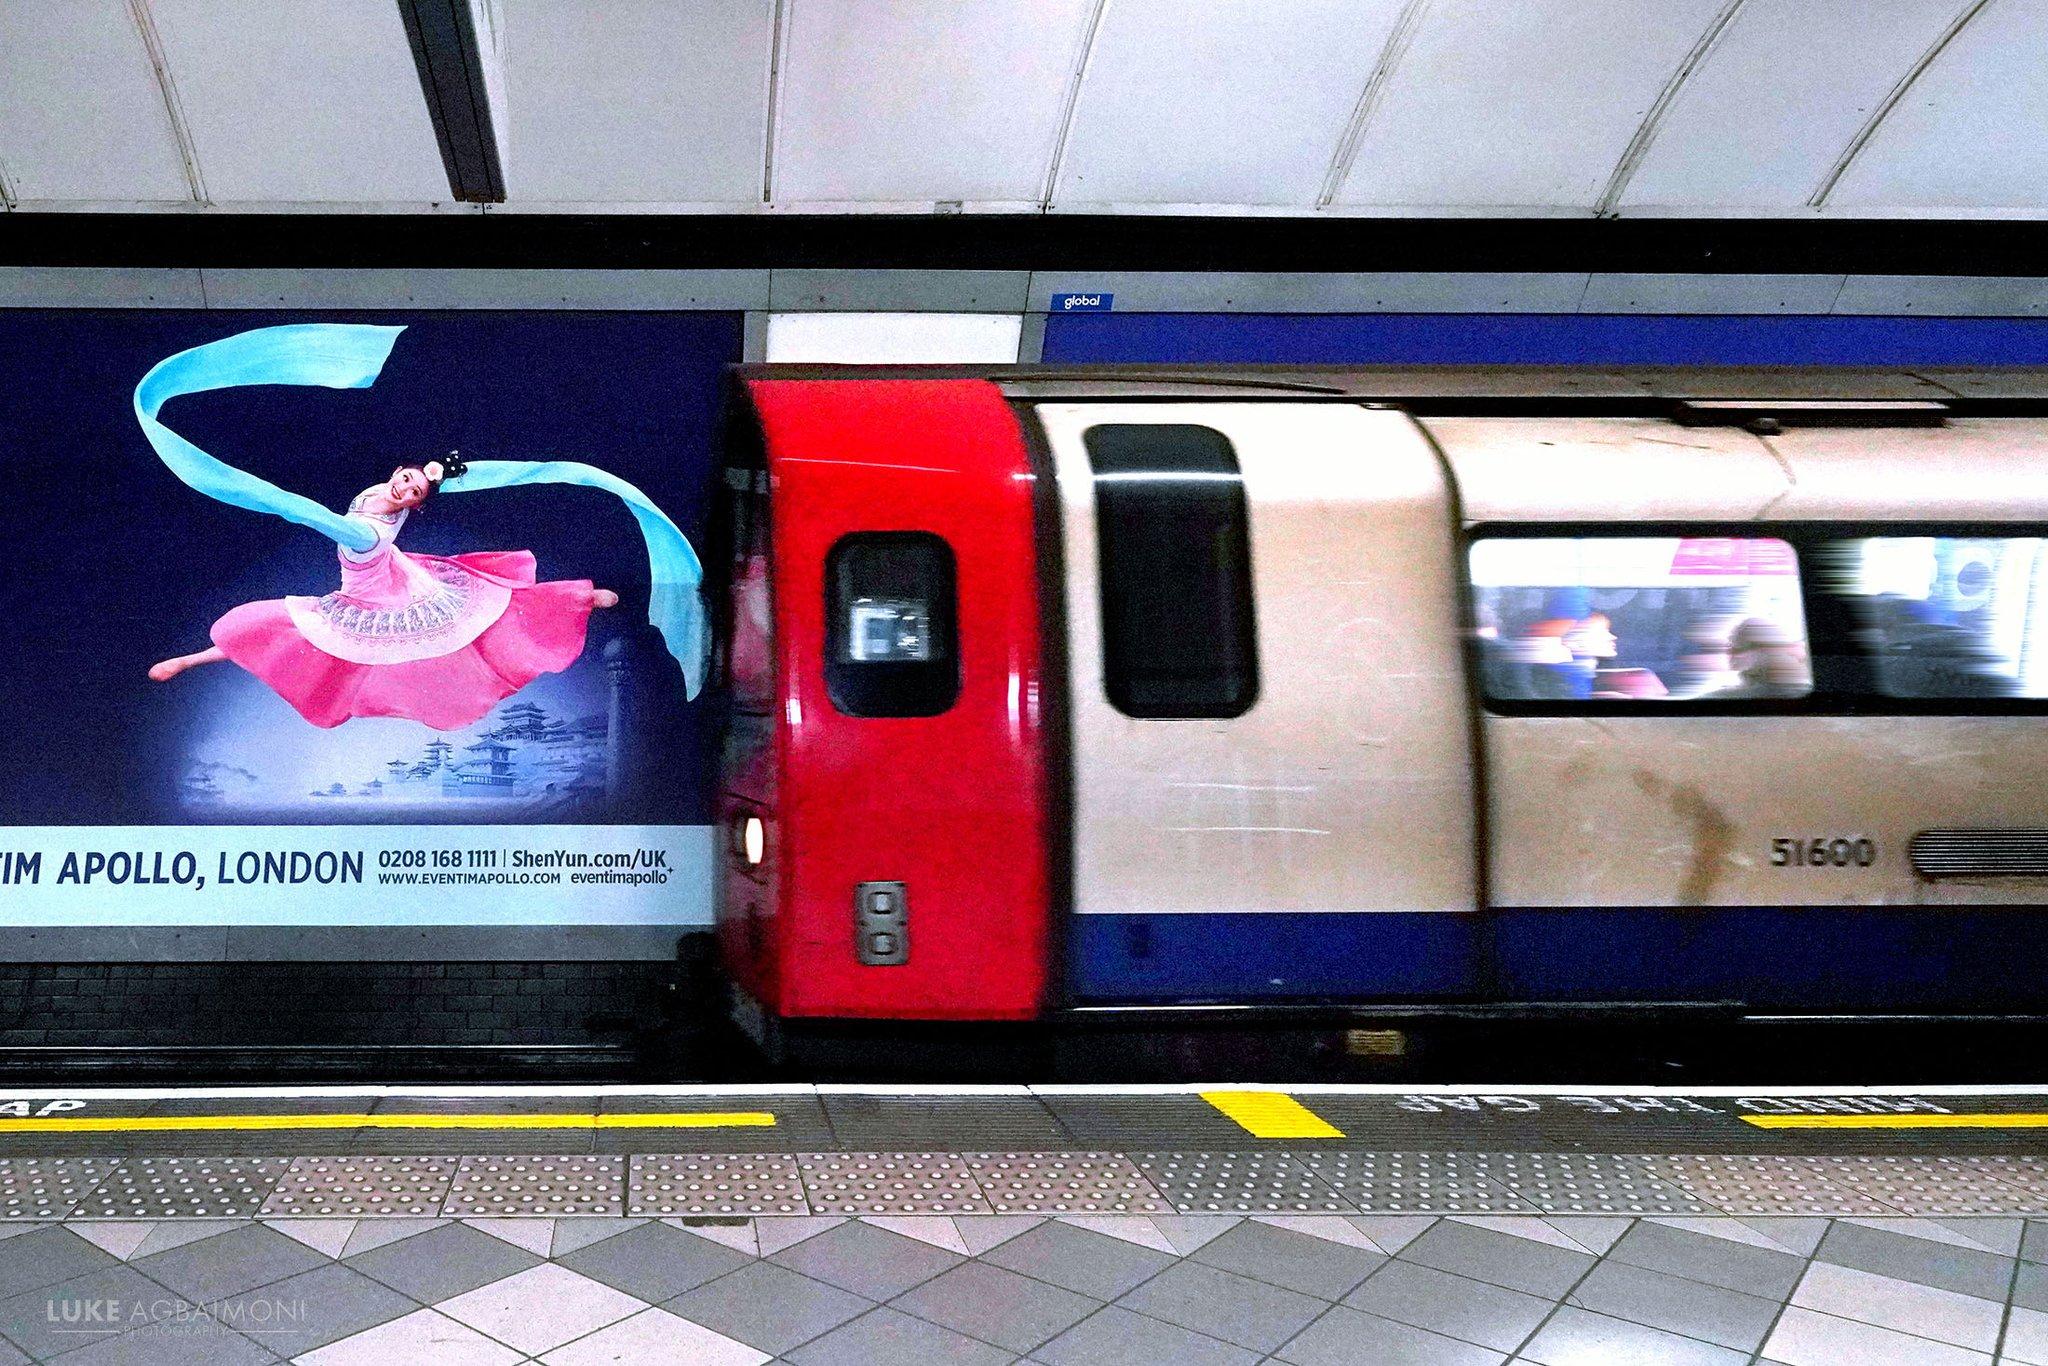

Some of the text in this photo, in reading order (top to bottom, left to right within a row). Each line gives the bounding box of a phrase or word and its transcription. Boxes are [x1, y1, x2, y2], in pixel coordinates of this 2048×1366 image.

[1064, 295, 1101, 309] global
[378, 849, 667, 868] 0208 168 1111 ShenYun.com/UK
[1771, 838, 1876, 867] 51600
[0, 851, 364, 891] IM APOLLO, LONDON
[378, 870, 668, 887] WWW.EVENTIMAPOLLO.COM eventimapollo
